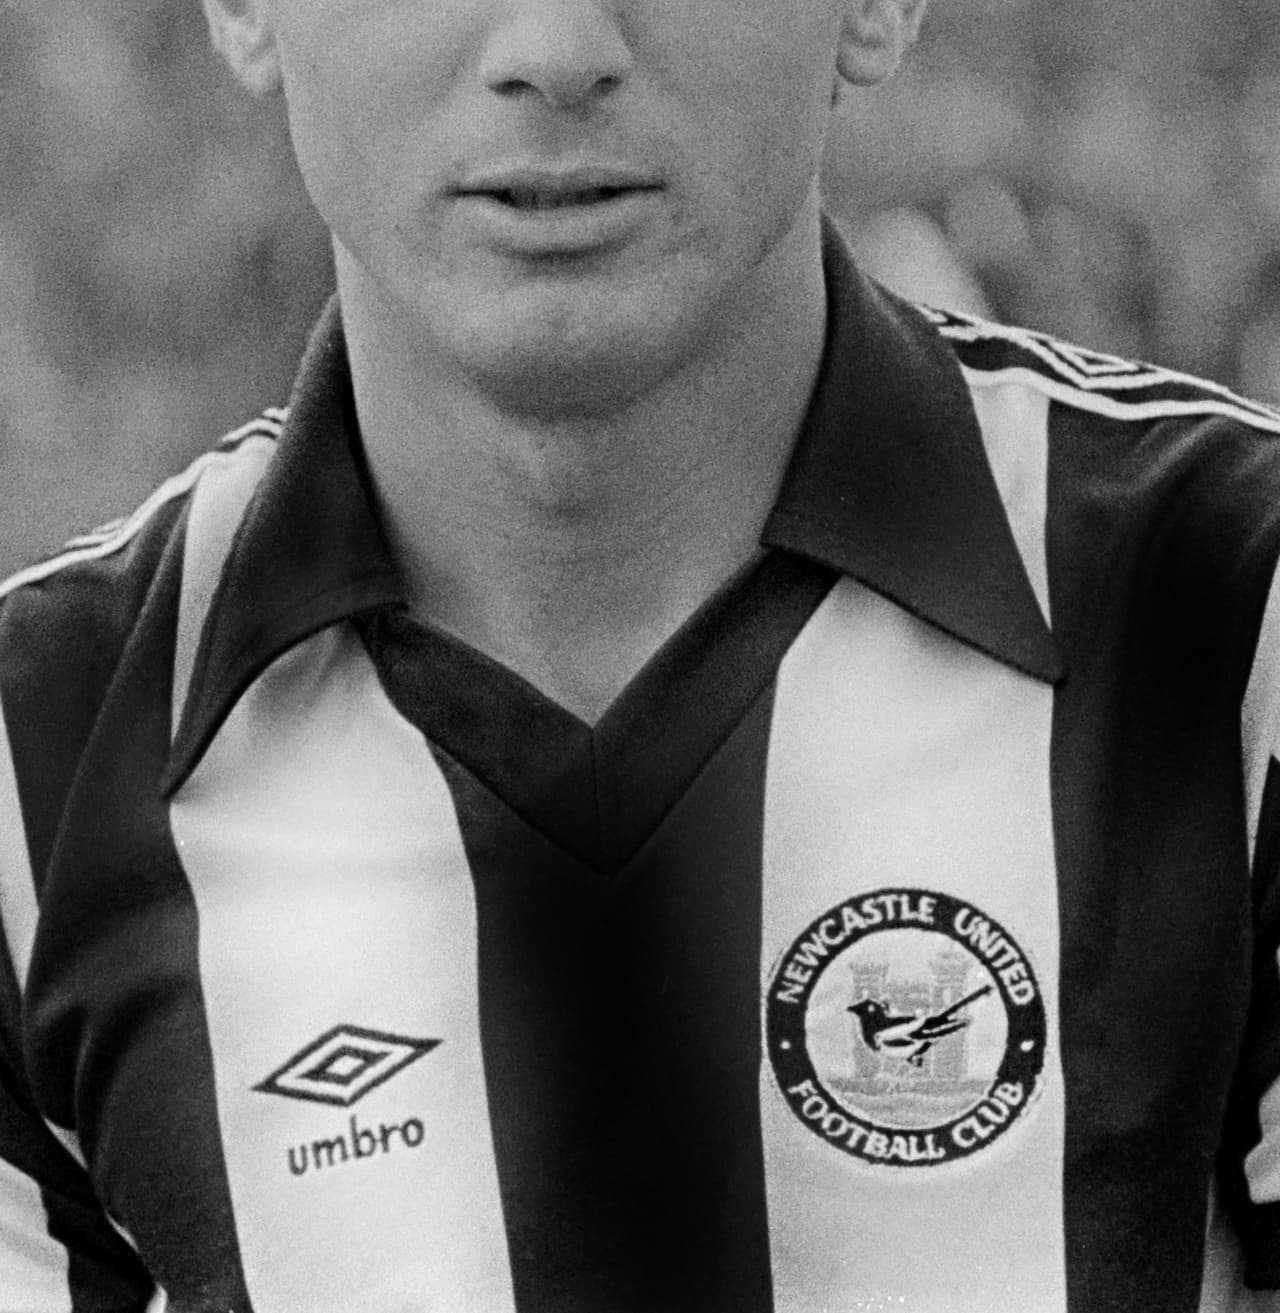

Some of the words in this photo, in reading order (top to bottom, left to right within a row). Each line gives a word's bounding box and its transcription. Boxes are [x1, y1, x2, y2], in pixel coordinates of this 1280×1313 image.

[776, 894, 937, 1004] NEWCASTLE
[953, 908, 1036, 1006] UNITED
[287, 1114, 425, 1176] umbro
[788, 1079, 946, 1162] FOOTBALL
[951, 1081, 1024, 1149] CLUB
